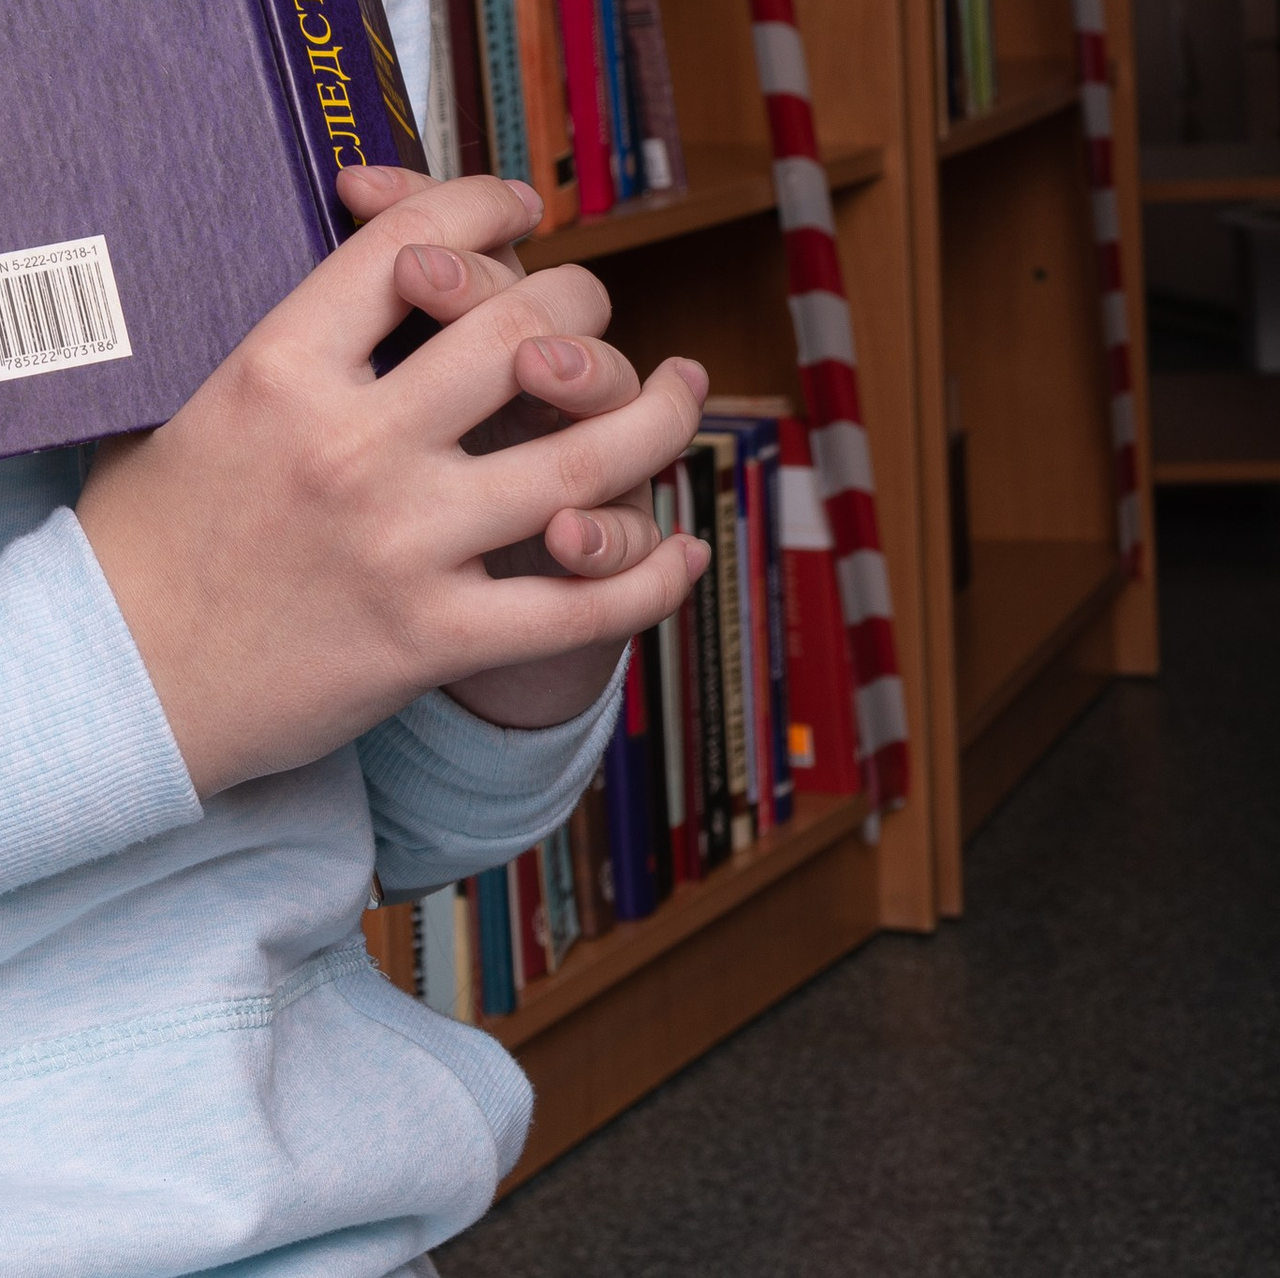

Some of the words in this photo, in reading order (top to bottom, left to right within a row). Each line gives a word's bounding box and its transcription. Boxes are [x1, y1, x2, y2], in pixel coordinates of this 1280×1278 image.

[12, 245, 98, 271] 5-222-07318-1
[5, 351, 58, 370] 785222
[62, 339, 114, 359] 073186
